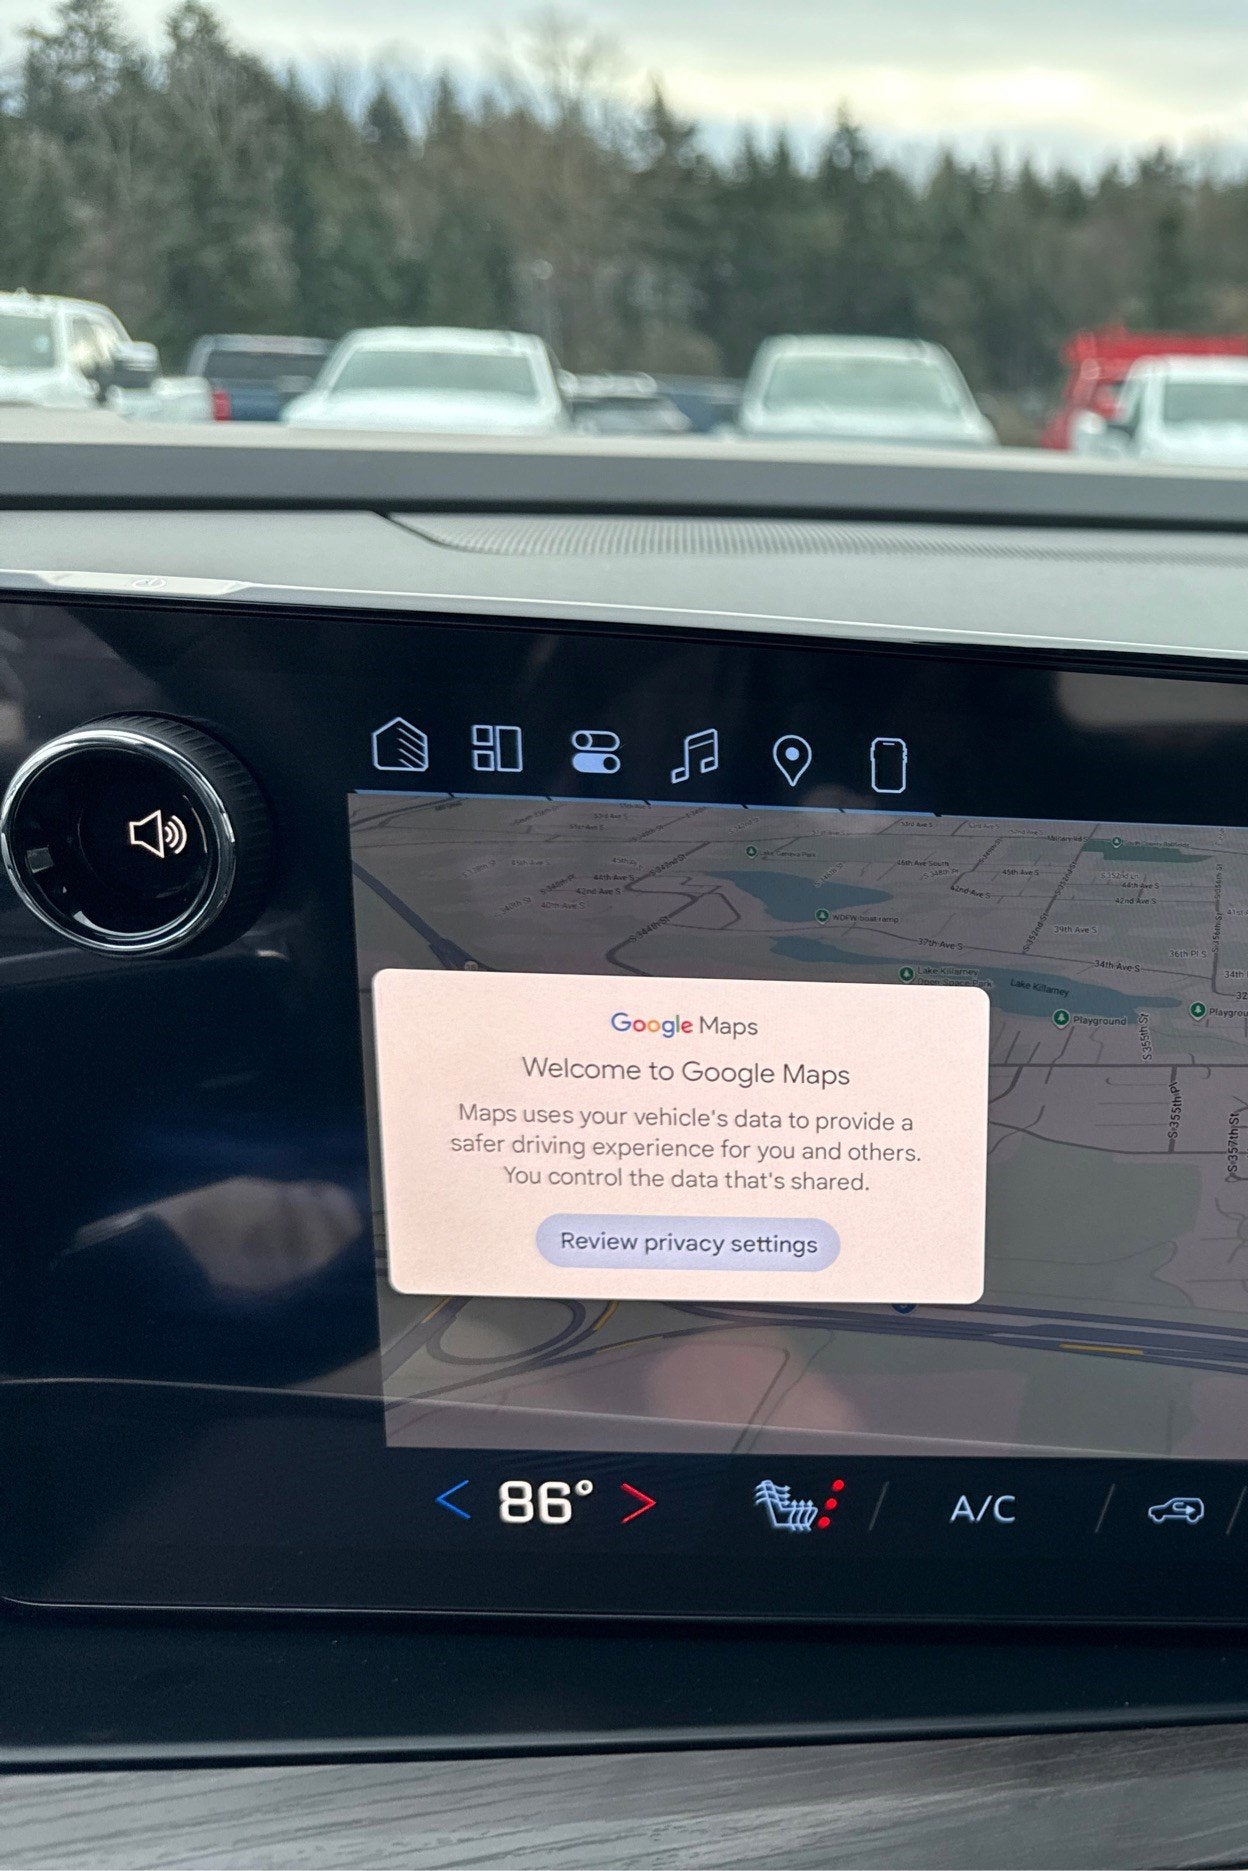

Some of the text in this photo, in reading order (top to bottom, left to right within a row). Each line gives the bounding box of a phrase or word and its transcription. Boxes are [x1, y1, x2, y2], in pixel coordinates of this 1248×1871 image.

[918, 938, 937, 949] 37th
[940, 940, 956, 950] Ave
[918, 966, 938, 974] Lake
[1094, 960, 1114, 970] 34th
[1117, 963, 1134, 972] Ave
[1224, 970, 1244, 978] 34th
[1011, 980, 1069, 997] Lake Killarney
[610, 1012, 758, 1040] Google Maps
[1073, 1016, 1126, 1026] Playground
[1141, 1026, 1152, 1052] 355th
[522, 1056, 850, 1089] Welcome to Google Maps
[458, 1103, 914, 1134] Maps uses your vehicle's data to provide a
[1170, 1096, 1181, 1129] 355th
[1168, 1130, 1178, 1138] S
[1228, 1112, 1240, 1172] S 357th St
[451, 1133, 921, 1163] safer driving experience for you and others.
[503, 1166, 870, 1191] You control the data that's shared.
[561, 1231, 818, 1258] Review privacy settings
[499, 1479, 594, 1524] 86°
[949, 1494, 1017, 1524] A/C
